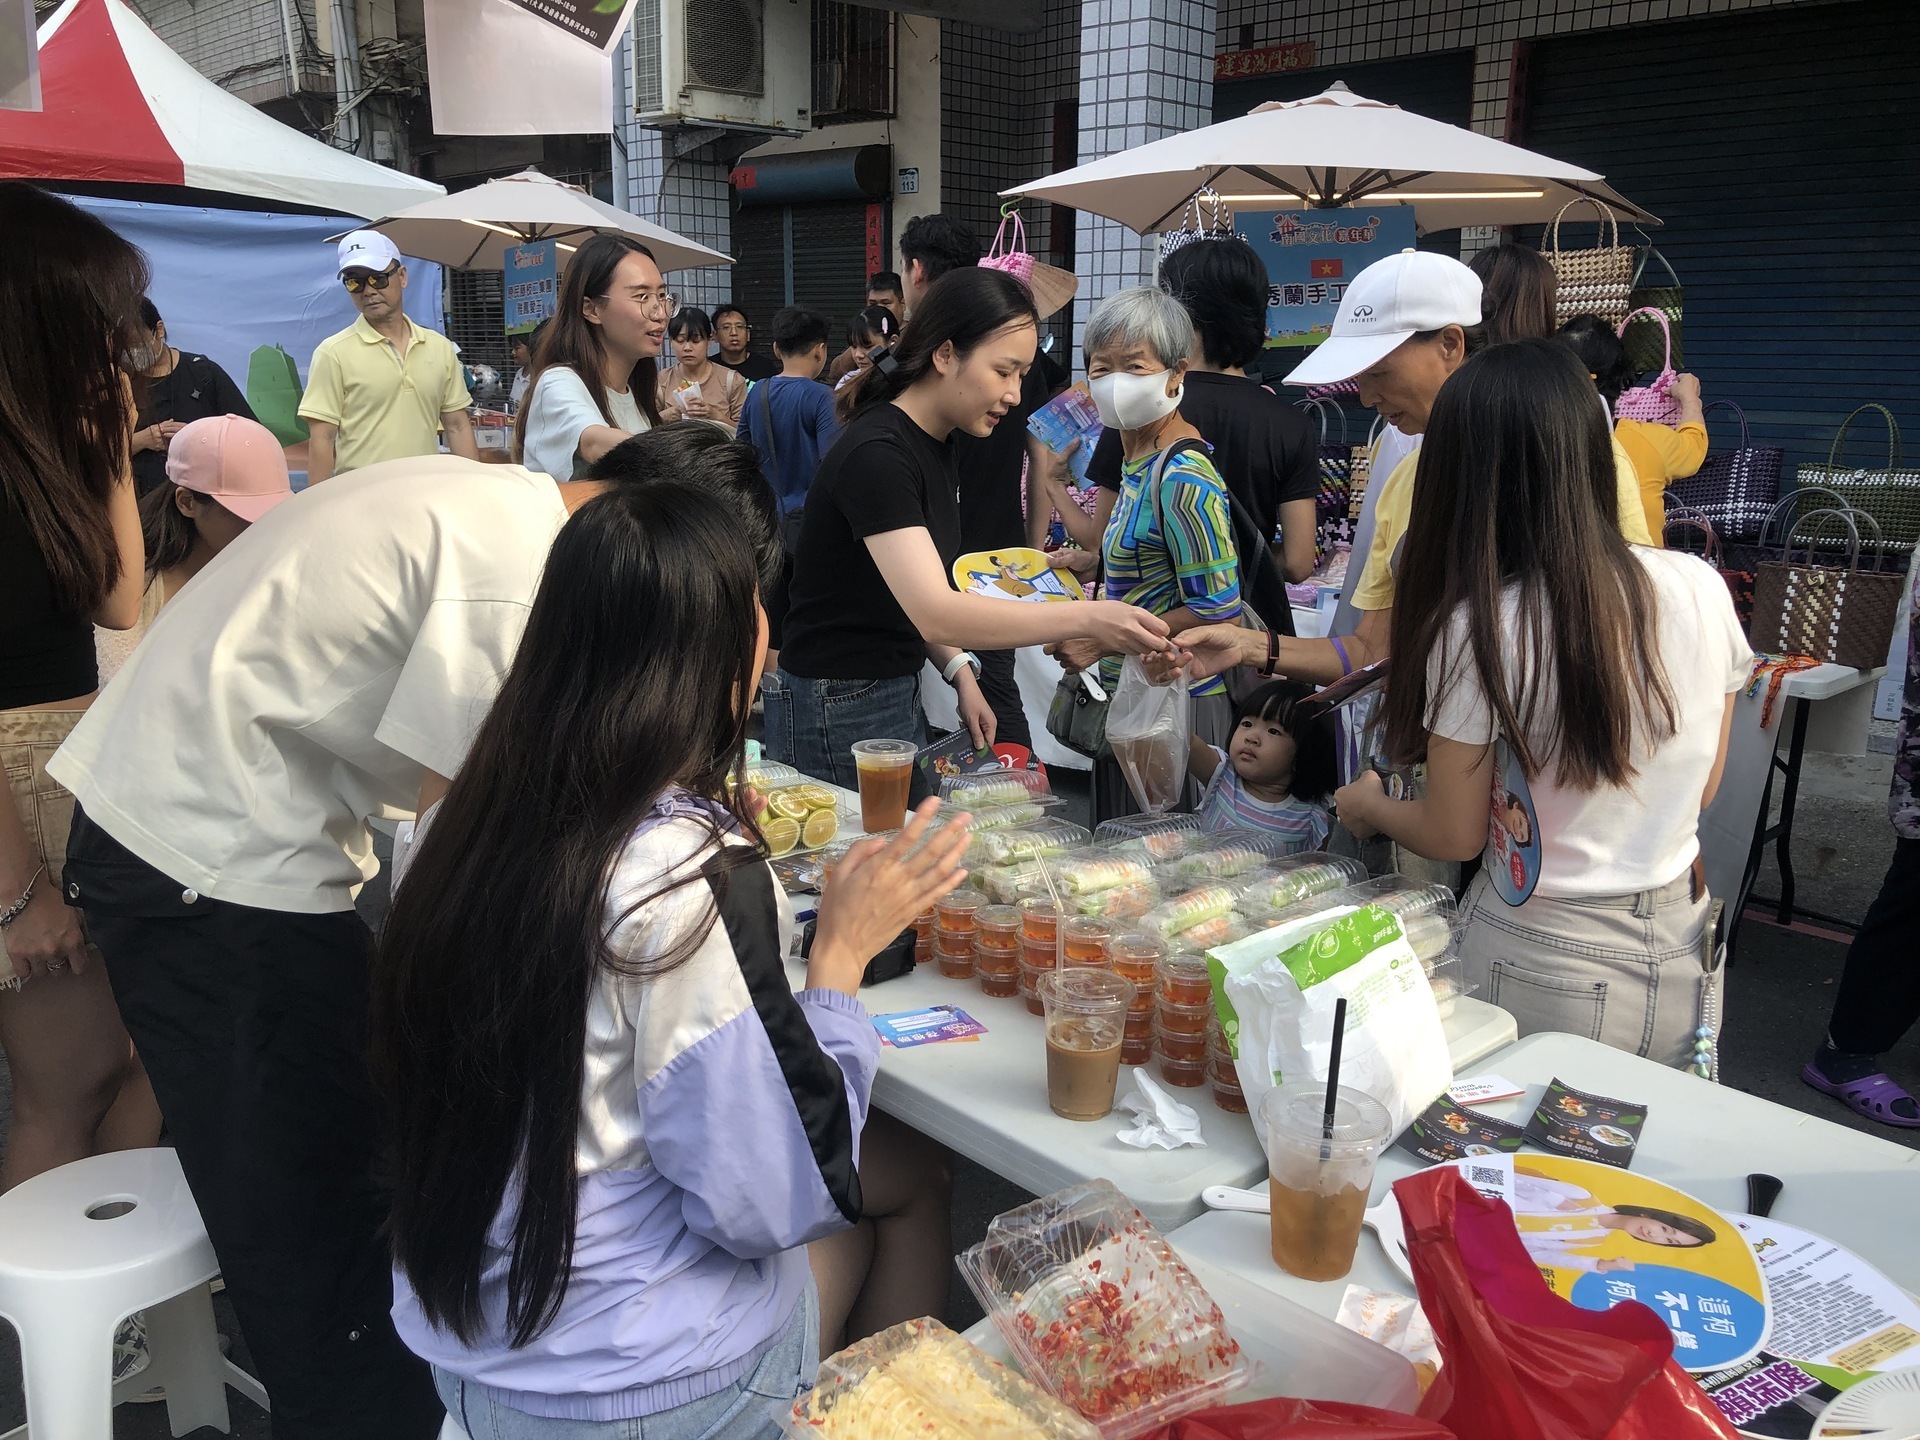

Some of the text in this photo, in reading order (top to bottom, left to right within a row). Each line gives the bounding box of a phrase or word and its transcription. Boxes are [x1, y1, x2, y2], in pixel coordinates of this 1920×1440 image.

[901, 181, 915, 191] 113
[1467, 226, 1487, 237] 114
[1546, 1134, 1600, 1155] FOOD MENU
[1417, 1147, 1444, 1163] MENU
[1697, 1294, 1738, 1338] 這柯
[1708, 1359, 1822, 1425] 賴瑞隆
